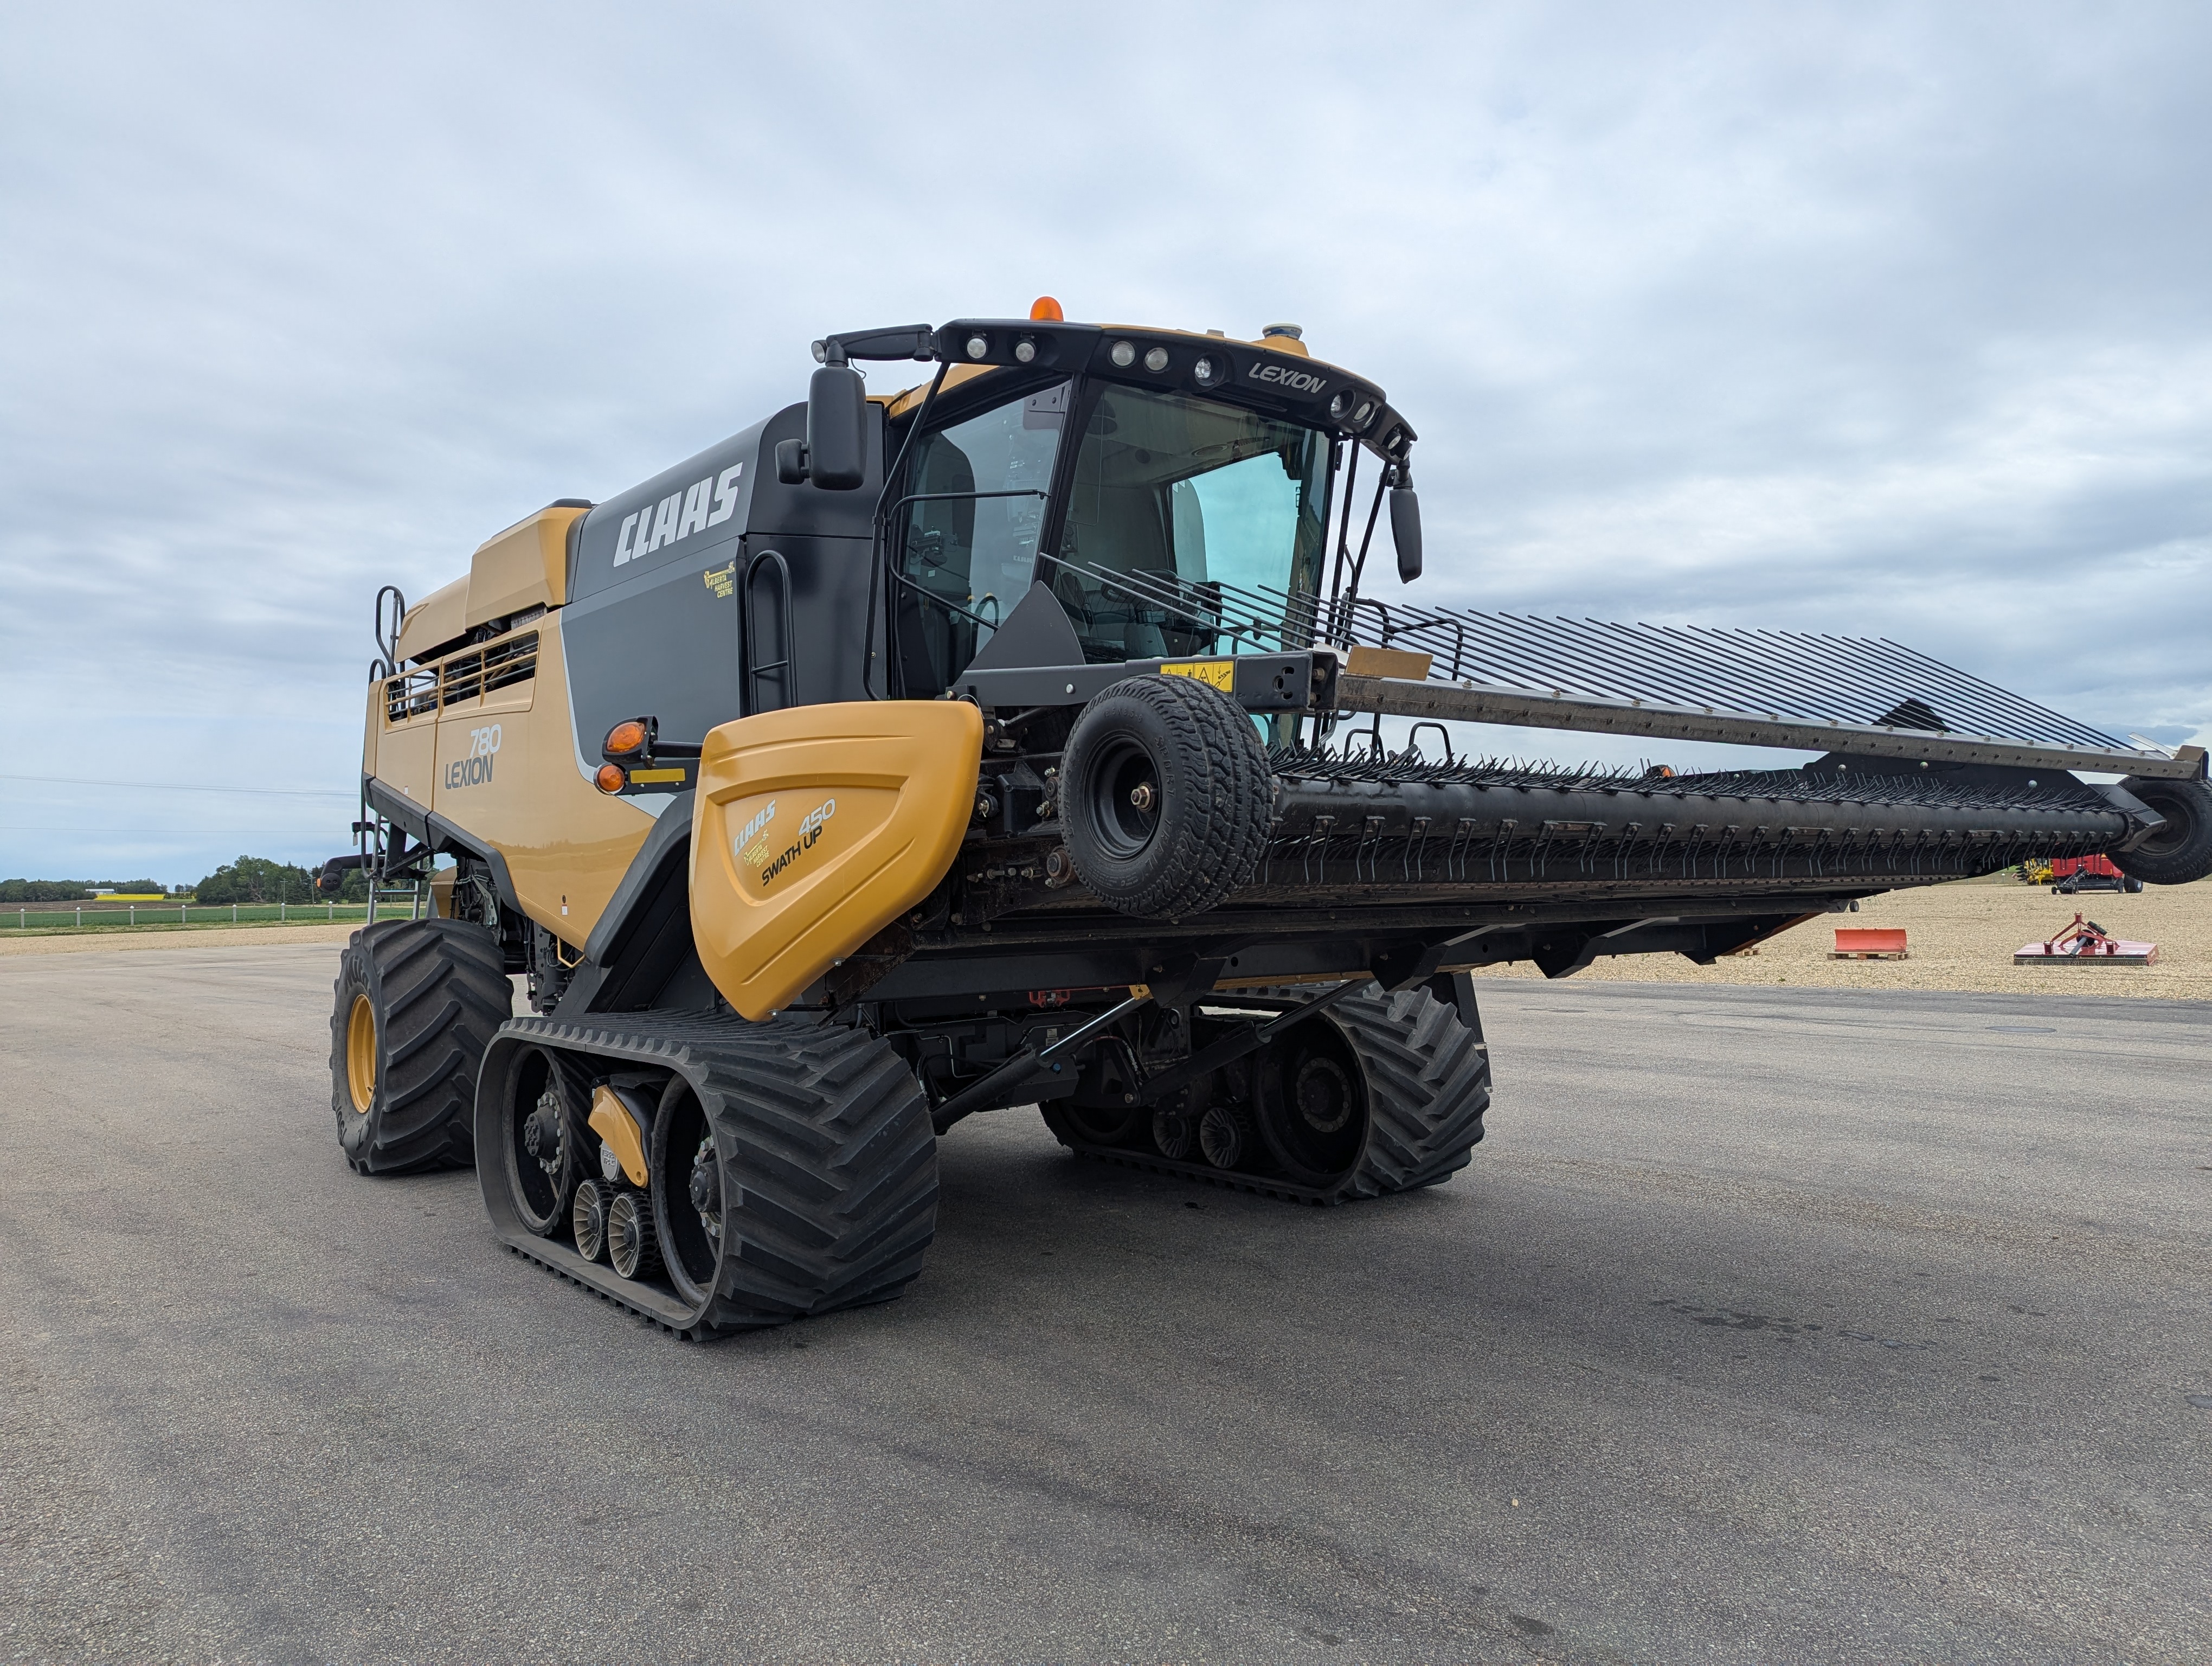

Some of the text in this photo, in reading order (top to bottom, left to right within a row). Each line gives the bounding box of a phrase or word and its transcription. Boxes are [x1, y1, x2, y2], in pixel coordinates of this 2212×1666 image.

[1249, 363, 1327, 394] LEXION
[613, 462, 743, 567] CLAAS
[710, 575, 726, 589] ALBERTA
[715, 580, 732, 592] HARVEST
[717, 587, 733, 598] CENTRE
[470, 724, 501, 758] 780
[445, 754, 494, 790] LEXION
[799, 798, 835, 836] 450
[1145, 736, 1175, 869] SPORT TRAIL
[735, 799, 776, 857] CLAAS
[749, 844, 762, 864] ALBERTA
[754, 845, 768, 864] HARVEST
[757, 850, 769, 867] CENTRE
[762, 825, 822, 887] SWATH UP
